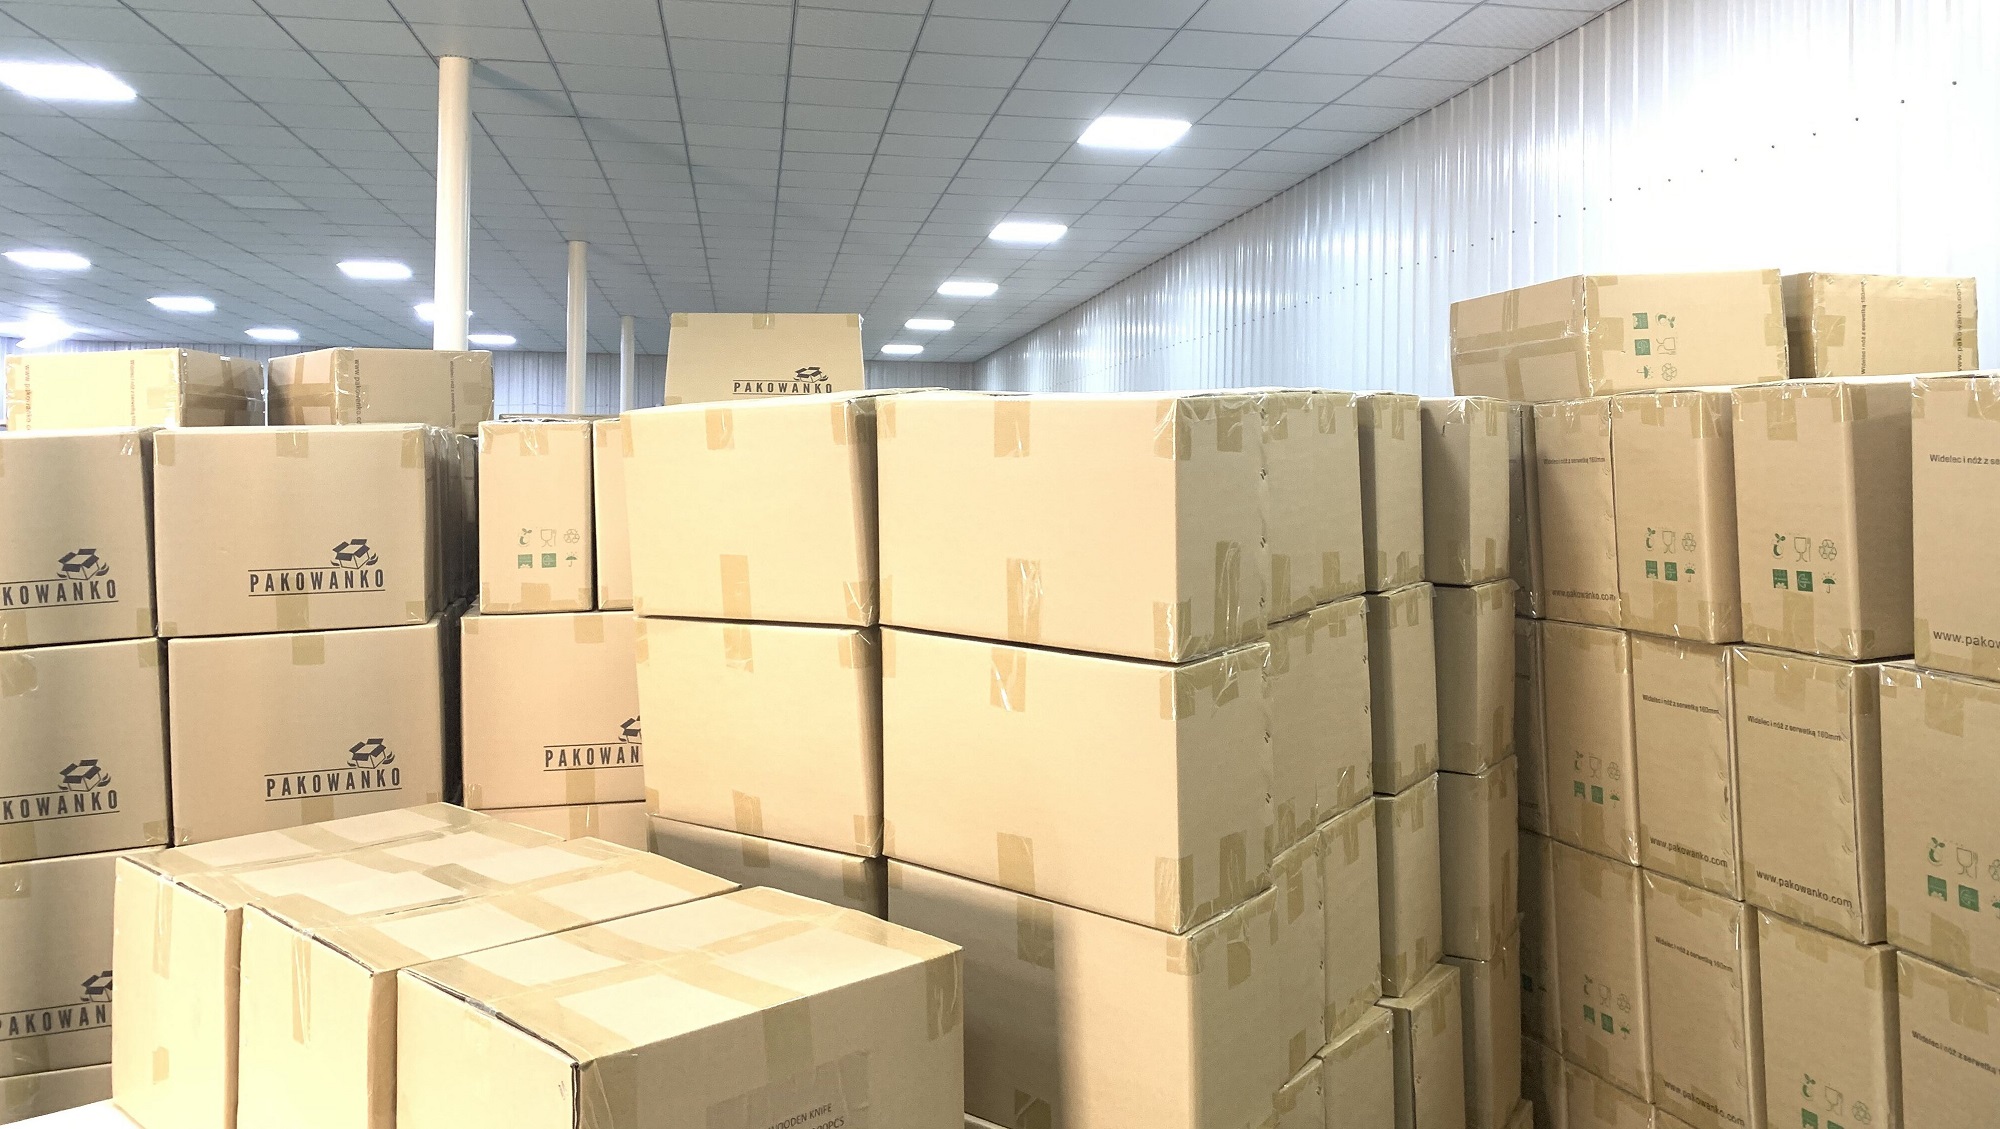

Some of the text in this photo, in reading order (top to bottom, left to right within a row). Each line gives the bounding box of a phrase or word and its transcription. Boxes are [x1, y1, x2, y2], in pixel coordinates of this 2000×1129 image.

[733, 382, 833, 394] PAKOWANKO
[1929, 454, 1962, 464] Widelec
[1967, 456, 1982, 465] nóż
[2, 579, 117, 606] KOWANKO
[250, 569, 384, 593] PAKOWANKO
[1551, 589, 1616, 602] www.pakowanko.com
[1747, 715, 1770, 726] Widelec
[1789, 725, 1816, 737] serwetką
[1817, 730, 1841, 741] 160mm
[545, 746, 639, 767] PAKOWAN
[266, 767, 400, 797] PAKOWANKO
[3, 790, 118, 820] KOWANKO
[1650, 836, 1728, 868] www.pakowanko.com
[1756, 869, 1853, 909] www.pakowanko.com
[0, 1004, 106, 1036] AKOWAN
[809, 1103, 833, 1119] KNIFE
